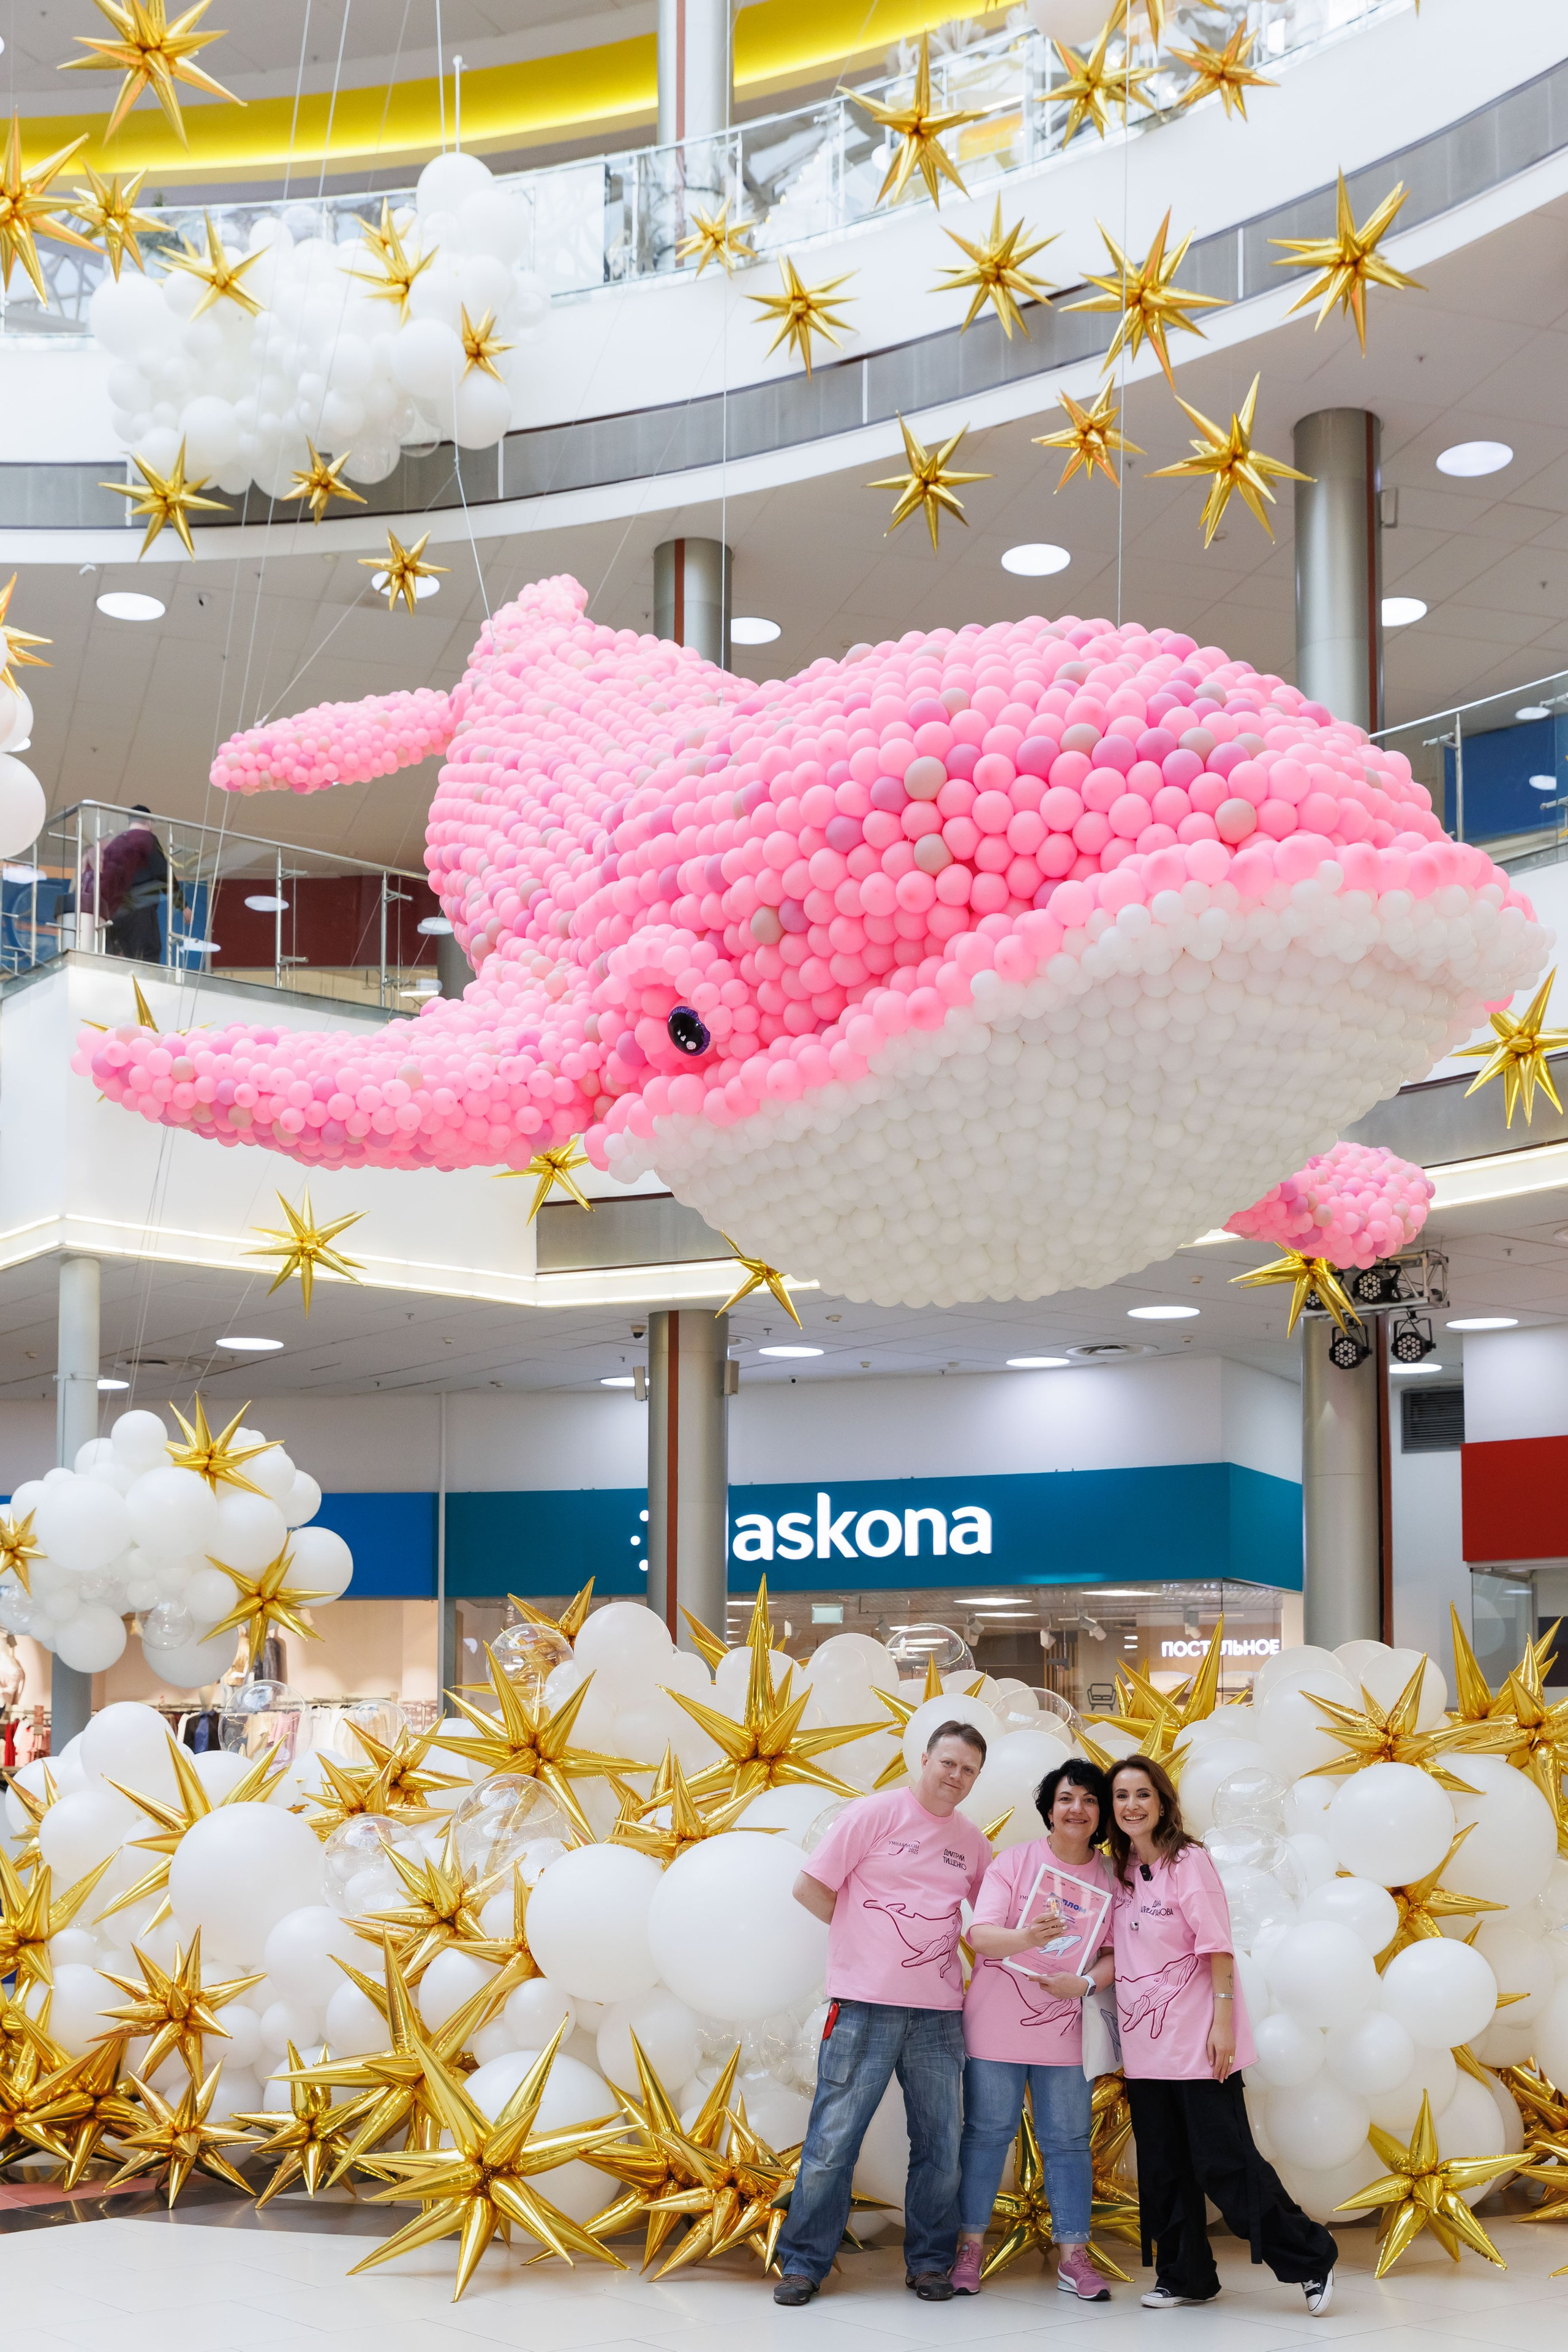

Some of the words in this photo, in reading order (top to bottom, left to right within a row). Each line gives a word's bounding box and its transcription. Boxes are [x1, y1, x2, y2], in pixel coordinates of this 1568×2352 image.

[733, 1492, 992, 1561] askona
[1161, 1638, 1280, 1657] ПОСТЛЬНОЕ
[943, 1849, 965, 1862] ДМИТРИЙ
[943, 1856, 967, 1870] ТИЩЕНКО
